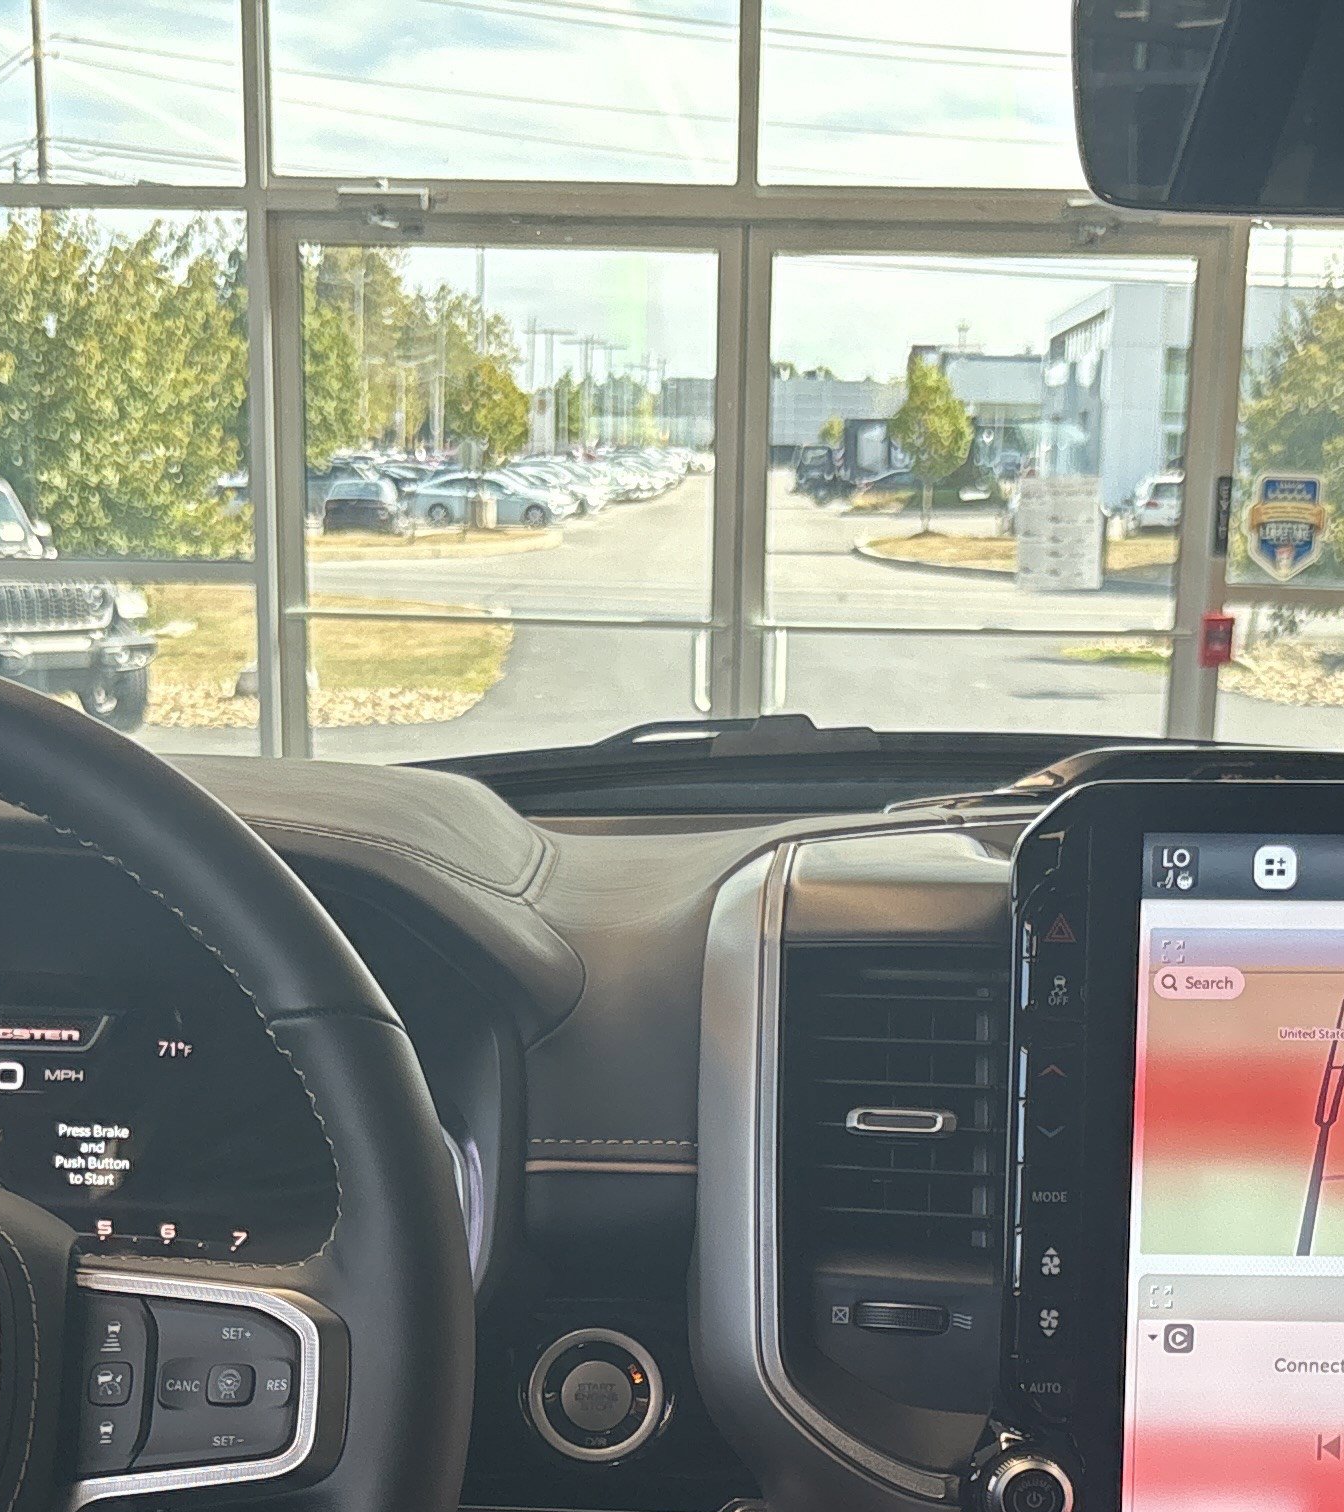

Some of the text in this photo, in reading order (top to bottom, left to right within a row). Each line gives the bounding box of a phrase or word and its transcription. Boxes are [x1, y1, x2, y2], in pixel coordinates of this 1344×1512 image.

[1162, 848, 1190, 868] LO
[1185, 975, 1234, 990] Search
[1048, 995, 1069, 1006] OFF
[1280, 1028, 1316, 1040] United
[44, 1069, 84, 1083] MPH
[58, 1124, 130, 1139] Press Brake
[80, 1141, 104, 1154] and
[55, 1156, 130, 1170] Push Button
[69, 1171, 114, 1186] to Start
[1032, 1192, 1068, 1203] MODE
[96, 1220, 113, 1234] 5
[160, 1223, 177, 1238] 6
[230, 1231, 248, 1246] 7
[165, 1379, 200, 1392] CANC
[266, 1379, 288, 1391] RES
[1030, 1383, 1062, 1395] AUTO
